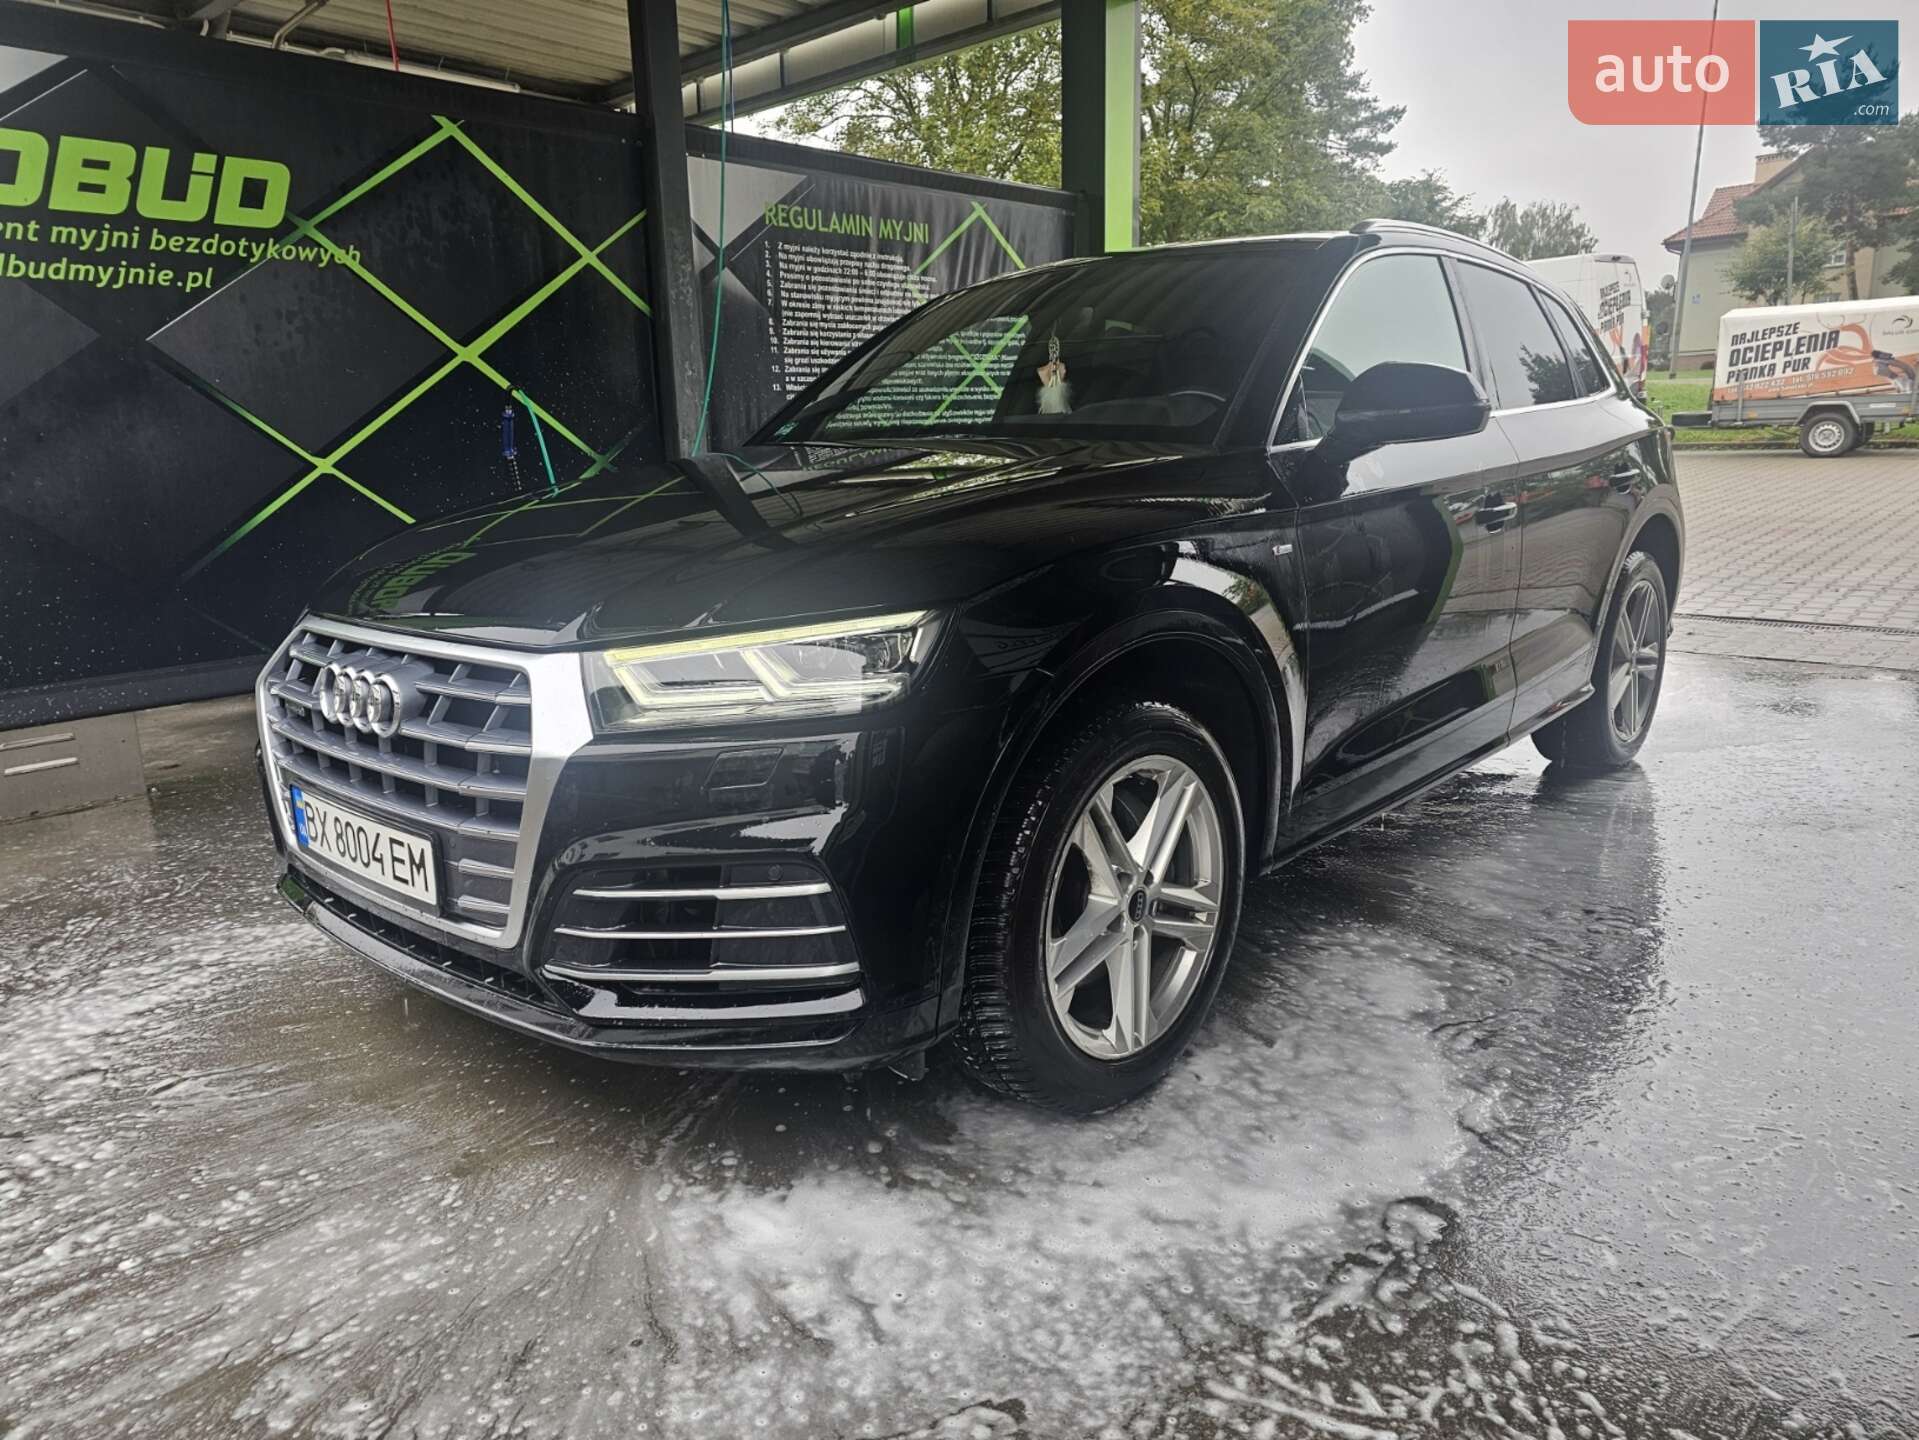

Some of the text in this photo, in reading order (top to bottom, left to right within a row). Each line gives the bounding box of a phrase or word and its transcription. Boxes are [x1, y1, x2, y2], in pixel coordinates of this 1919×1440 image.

[764, 202, 930, 244] REGULAMIN MYJNI
[50, 224, 141, 252] myjni
[149, 228, 361, 267] bezdotykowych
[1729, 329, 1841, 367] OCIEPLENIA
[1731, 321, 1800, 347] NAJLEPSZE
[1782, 356, 1812, 375] PUR
[334, 817, 384, 876] 8004
[389, 838, 428, 892] EM
